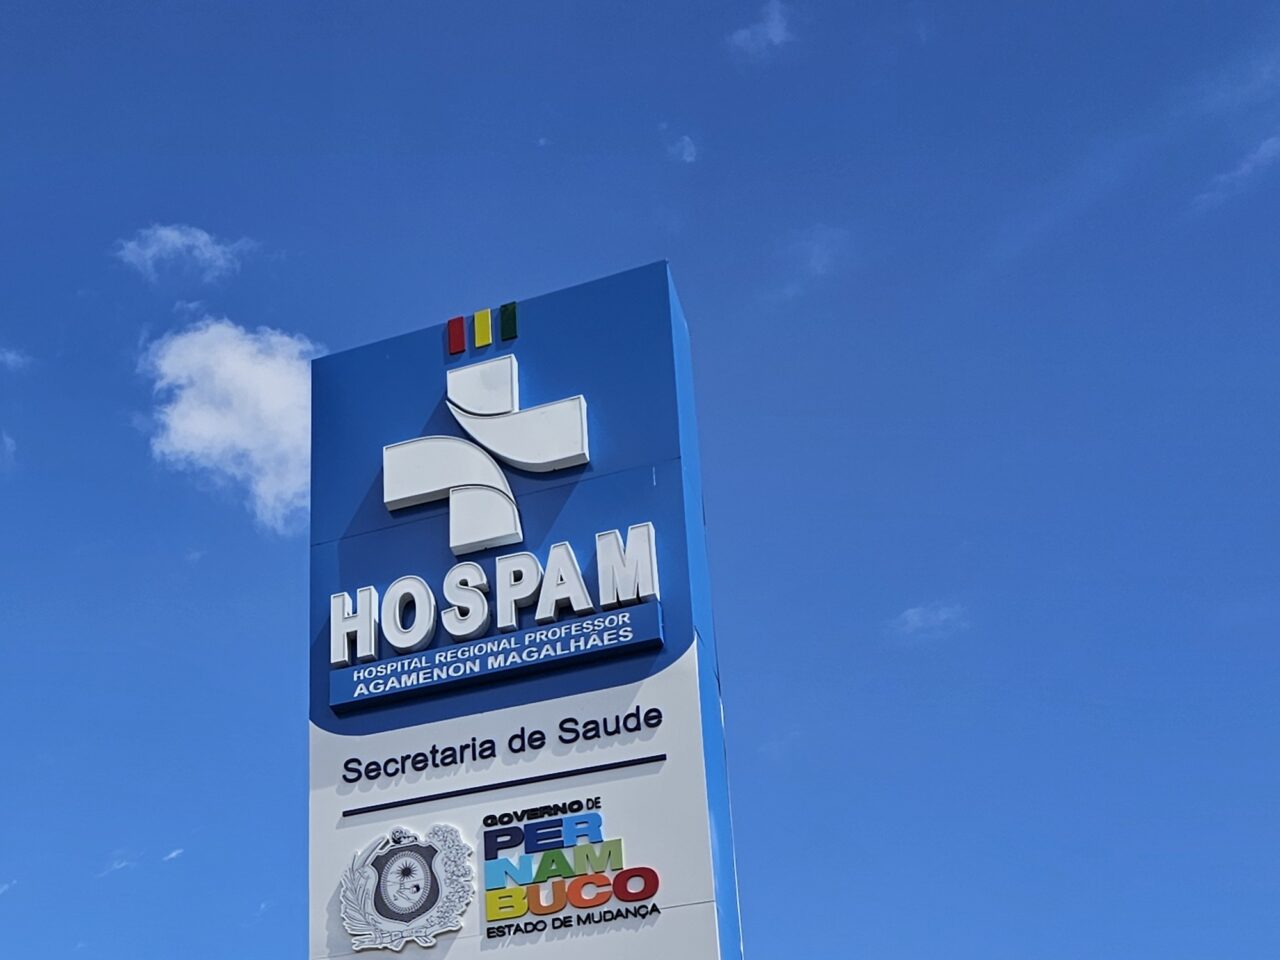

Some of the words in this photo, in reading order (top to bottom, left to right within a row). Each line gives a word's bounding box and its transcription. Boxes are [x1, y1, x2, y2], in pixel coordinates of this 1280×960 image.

[330, 521, 660, 666] HOSPAM
[353, 658, 429, 681] HOSPITAL
[435, 639, 520, 663] REGIONAL
[524, 612, 630, 644] PROFESSOR
[353, 660, 480, 697] AGAMENON
[467, 627, 633, 668] MAGALHÃES
[342, 736, 496, 784] Secretaria
[508, 726, 546, 753] de
[558, 705, 663, 744] Saude
[483, 799, 584, 827] GOVERNO
[586, 797, 602, 810] DE
[484, 812, 603, 861] PER
[484, 838, 624, 891] NAM
[485, 867, 660, 922] BUCO
[486, 920, 547, 938] ESTADO
[551, 915, 573, 930] DE
[577, 903, 661, 926] MUDANÇA
